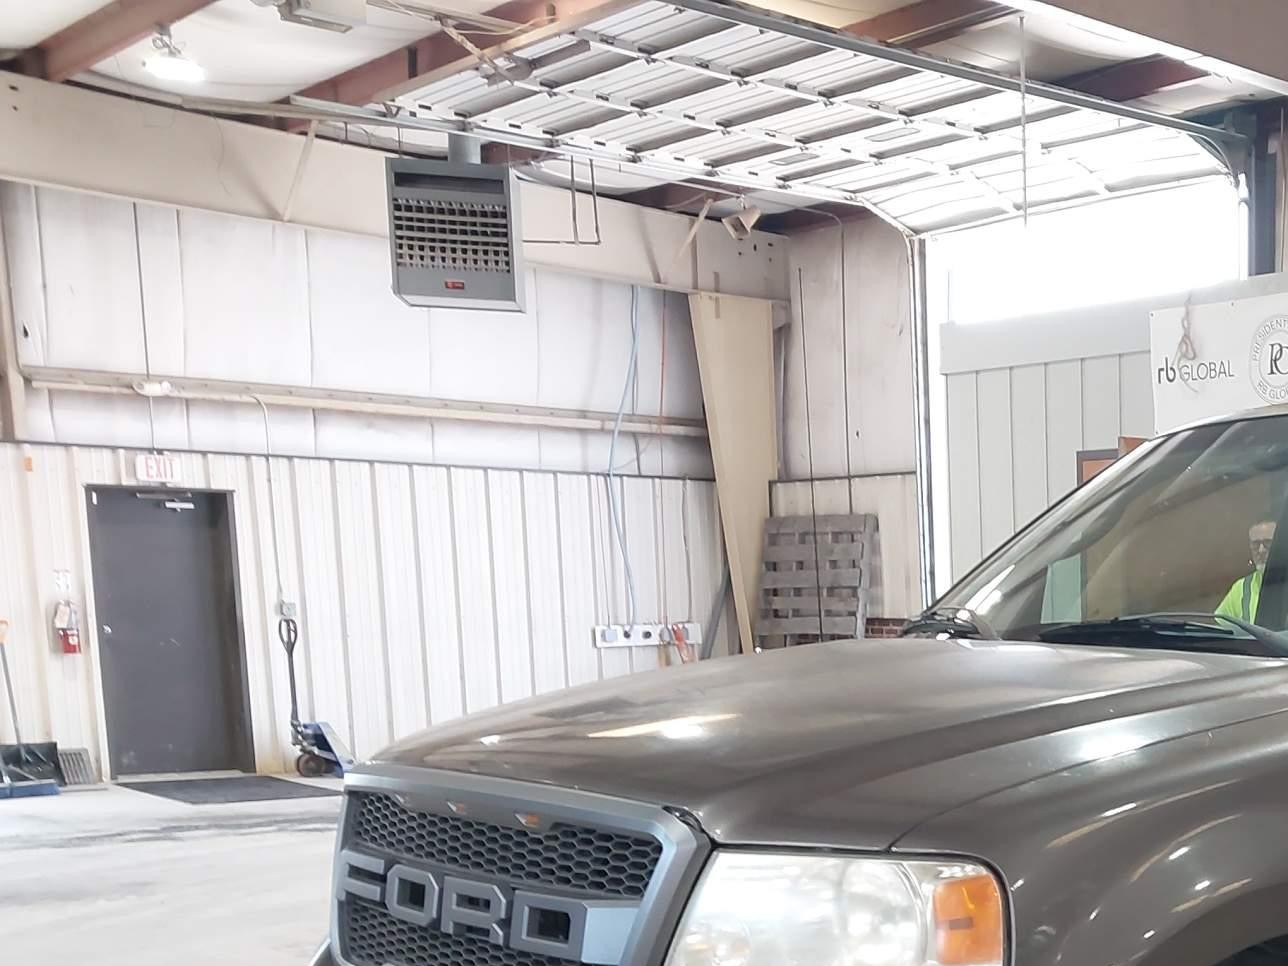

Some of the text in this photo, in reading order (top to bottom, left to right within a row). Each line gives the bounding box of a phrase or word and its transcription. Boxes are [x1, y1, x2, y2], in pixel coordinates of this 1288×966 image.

[1157, 357, 1235, 385] rb GLOBAL
[145, 456, 175, 479] EXIT
[336, 848, 590, 963] FORD
